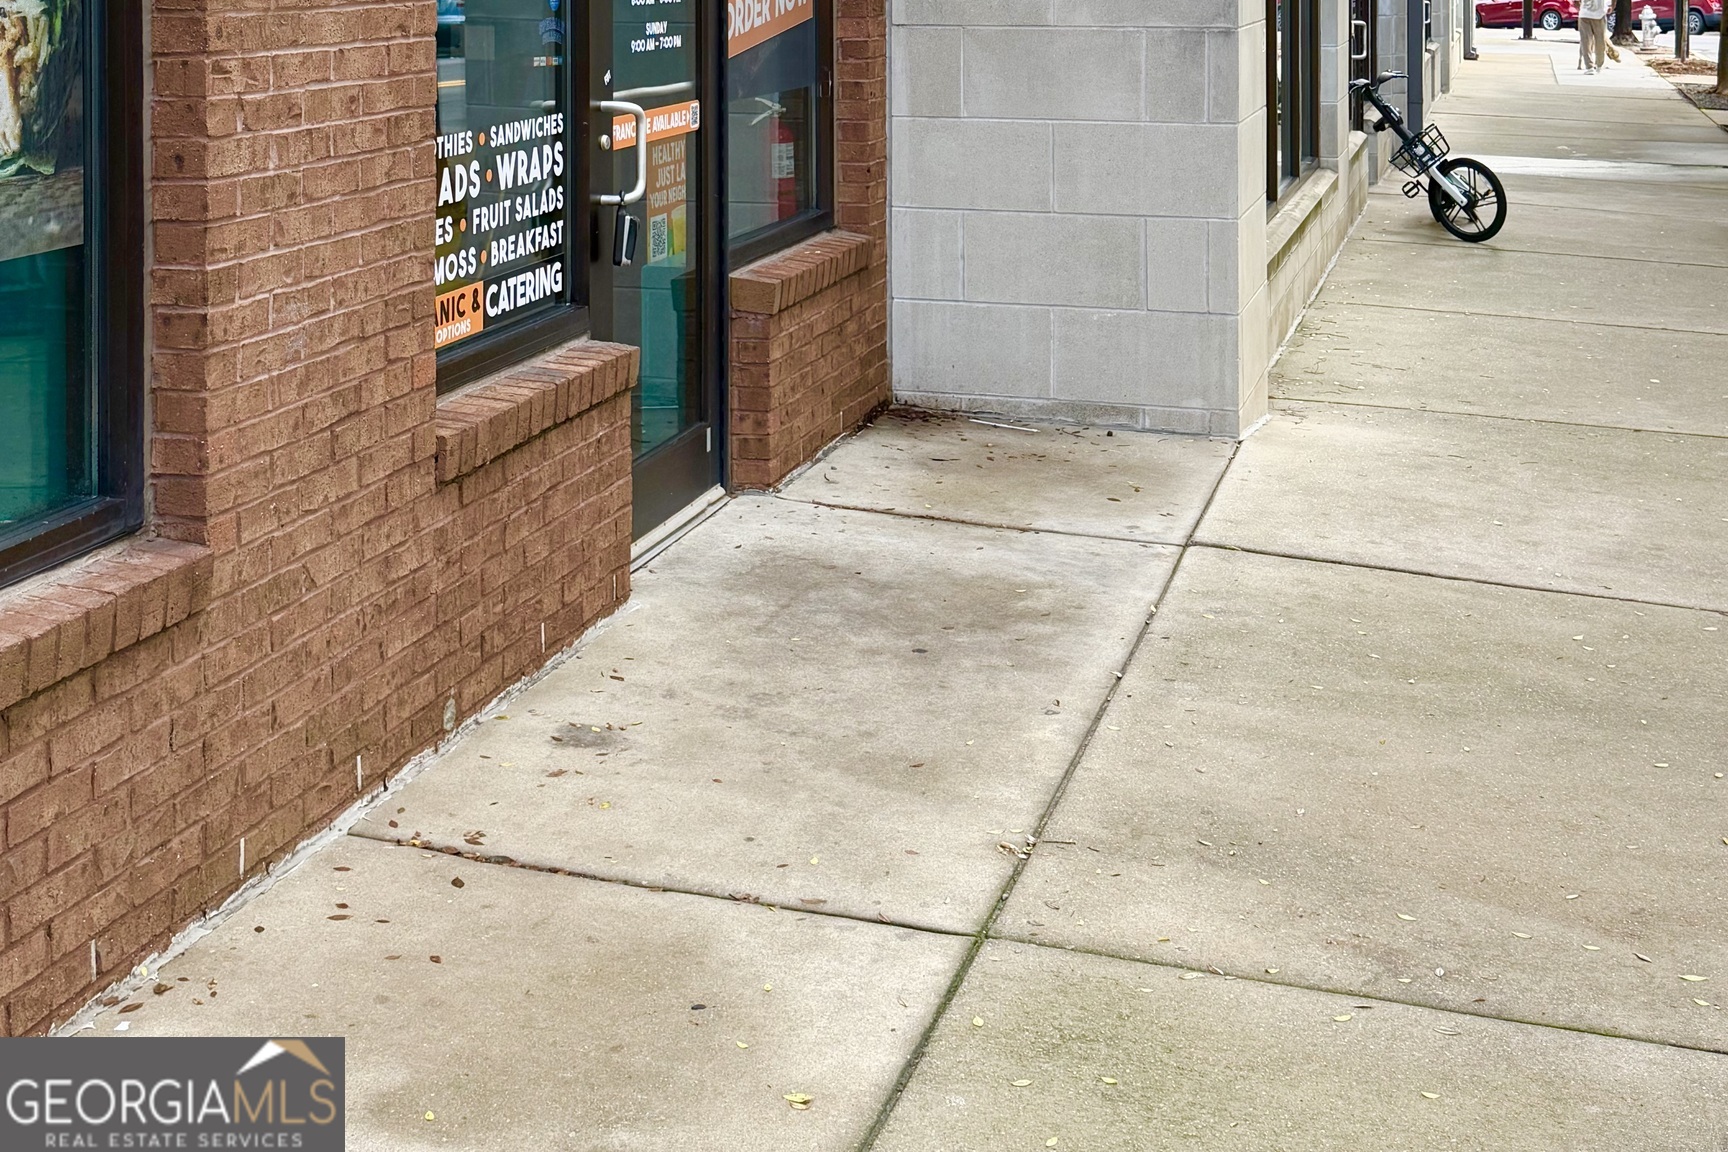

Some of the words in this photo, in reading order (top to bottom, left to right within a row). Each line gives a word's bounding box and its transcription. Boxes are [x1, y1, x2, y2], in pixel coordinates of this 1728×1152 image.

[645, 21, 668, 35] SUNDAY
[646, 37, 655, 51] AM
[659, 35, 673, 50] 7:00
[673, 34, 682, 48] PM
[652, 110, 686, 133] AVAILABLE
[434, 130, 473, 159] THIES
[490, 112, 564, 148] SANDWICHES
[495, 141, 564, 191] WRAPS
[652, 139, 686, 166] HEALTHY
[656, 164, 675, 188] JUST
[472, 199, 511, 235] FRUIT
[515, 185, 564, 222] SALADS
[650, 189, 668, 209] YOUR
[490, 220, 564, 267] BREAKFAST
[471, 287, 480, 314] &
[485, 261, 563, 318] CATERING
[436, 318, 471, 344] OPTIONS
